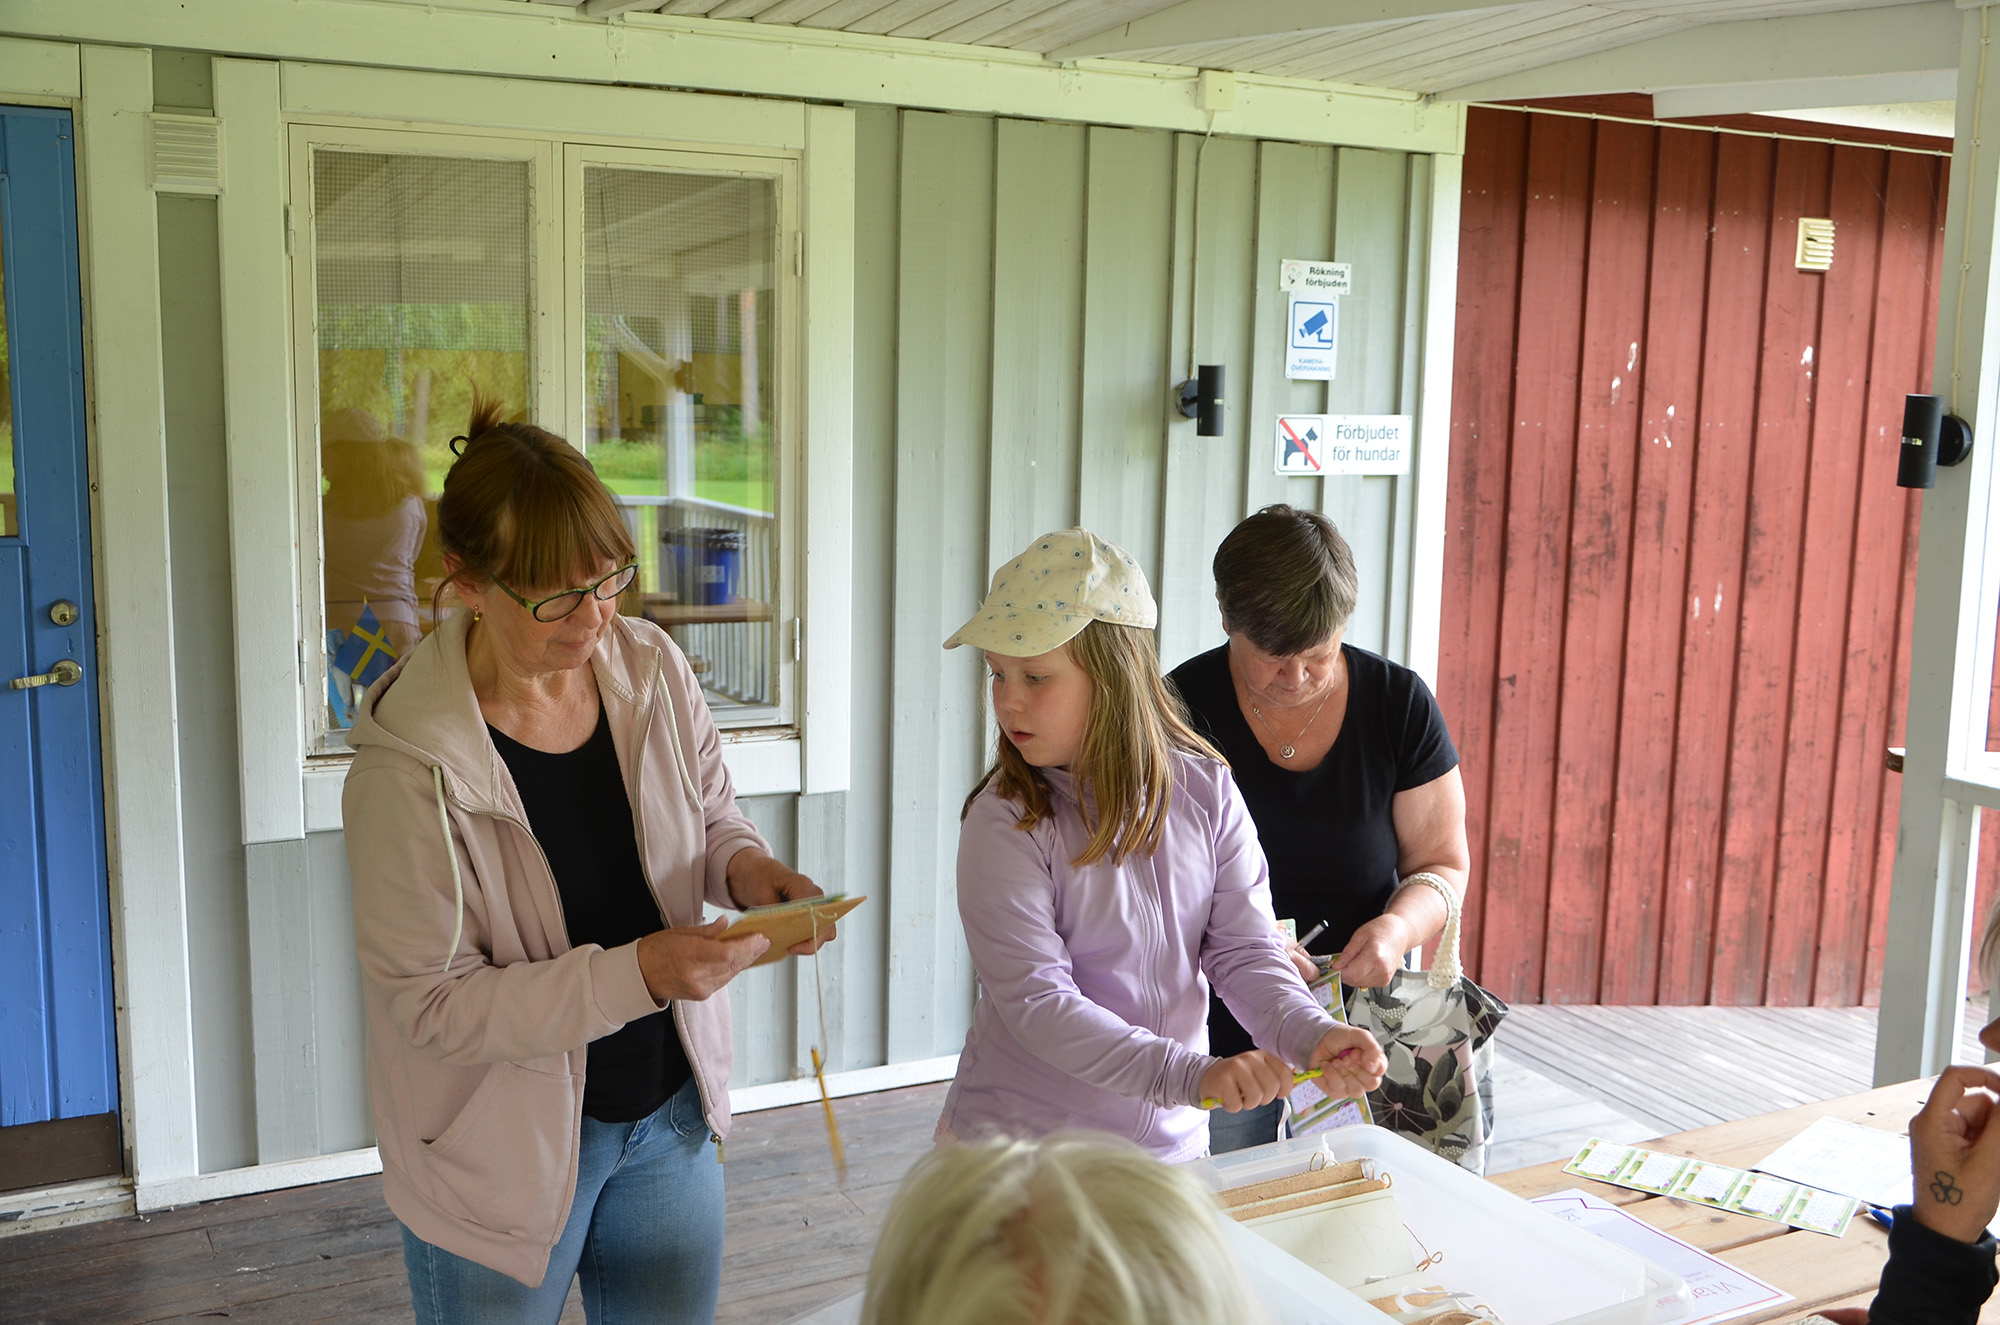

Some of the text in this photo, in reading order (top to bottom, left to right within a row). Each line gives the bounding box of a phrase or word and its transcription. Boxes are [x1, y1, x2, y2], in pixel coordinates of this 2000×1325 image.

[1309, 266, 1345, 278] Rökning
[1305, 277, 1348, 288] förbjuden
[1336, 425, 1399, 443] Förbjudet
[1332, 446, 1400, 461] för hundar
